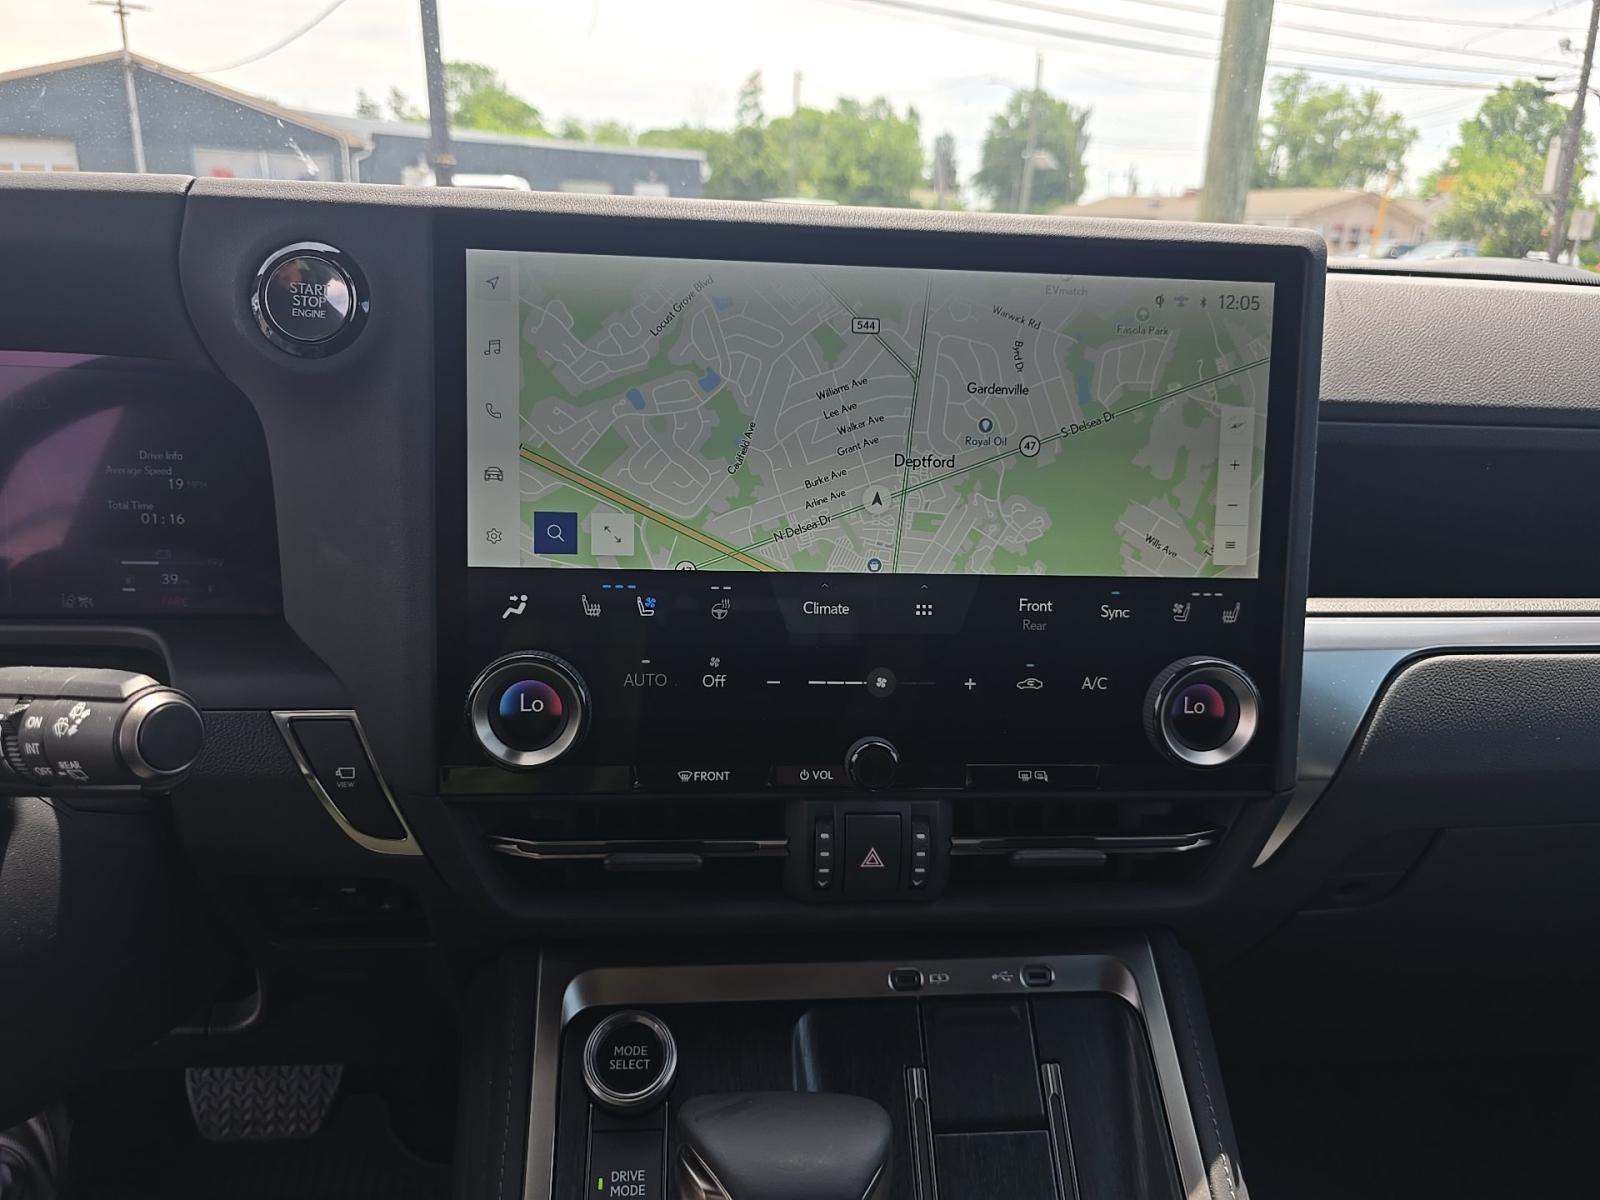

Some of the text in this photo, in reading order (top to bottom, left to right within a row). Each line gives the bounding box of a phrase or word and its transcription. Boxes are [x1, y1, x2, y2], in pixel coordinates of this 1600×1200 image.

[289, 282, 329, 296] START
[1045, 285, 1088, 297] EVmatch
[292, 295, 326, 308] STOP
[649, 274, 714, 336] Locust Grove Blvd
[1219, 295, 1261, 311] 12:05
[292, 308, 326, 318] ENGINE
[992, 304, 1042, 331] Warwick Rd
[857, 320, 876, 331] 544
[1116, 323, 1169, 336] Fasola Park
[1014, 340, 1024, 373] Byrd Dr
[816, 377, 868, 400] Williams Ave
[967, 382, 1029, 396] Gardenville
[823, 402, 858, 420] Lee Ave
[837, 414, 885, 436] Walker Ave
[1061, 412, 1116, 438] S Delsea Dr
[727, 421, 756, 475] Caulfield Ave
[837, 436, 880, 457] Grant Ave
[965, 436, 1007, 448] Royal Oil
[1023, 441, 1036, 452] 47
[138, 450, 183, 461] Drive Info
[894, 453, 956, 472] Deptford
[104, 465, 172, 477] Average Speed
[168, 478, 184, 490] 19
[804, 468, 848, 490] Burke Ave
[107, 500, 154, 511] Total Time
[804, 489, 847, 510] Arline Ave
[140, 512, 185, 525] 01:16
[773, 515, 832, 543] N Delsea Dr
[1145, 534, 1162, 550] Wills
[161, 573, 179, 585] 39
[802, 601, 850, 617] Climate
[1018, 598, 1052, 612] Front
[1100, 605, 1130, 621] Sync
[1022, 619, 1047, 631] Rear
[624, 673, 667, 687] AUTO
[702, 674, 727, 687] Off
[1082, 677, 1107, 692] A/C
[519, 693, 544, 713] Lo
[1184, 697, 1205, 714] Lo
[25, 716, 43, 728] ON
[25, 742, 40, 754] INT
[694, 771, 730, 782] FRONT
[812, 770, 833, 781] VOL
[614, 1046, 648, 1056] MODE
[609, 1059, 650, 1070] SELECT
[611, 1170, 645, 1182] DRIVE
[610, 1185, 645, 1196] MODE
